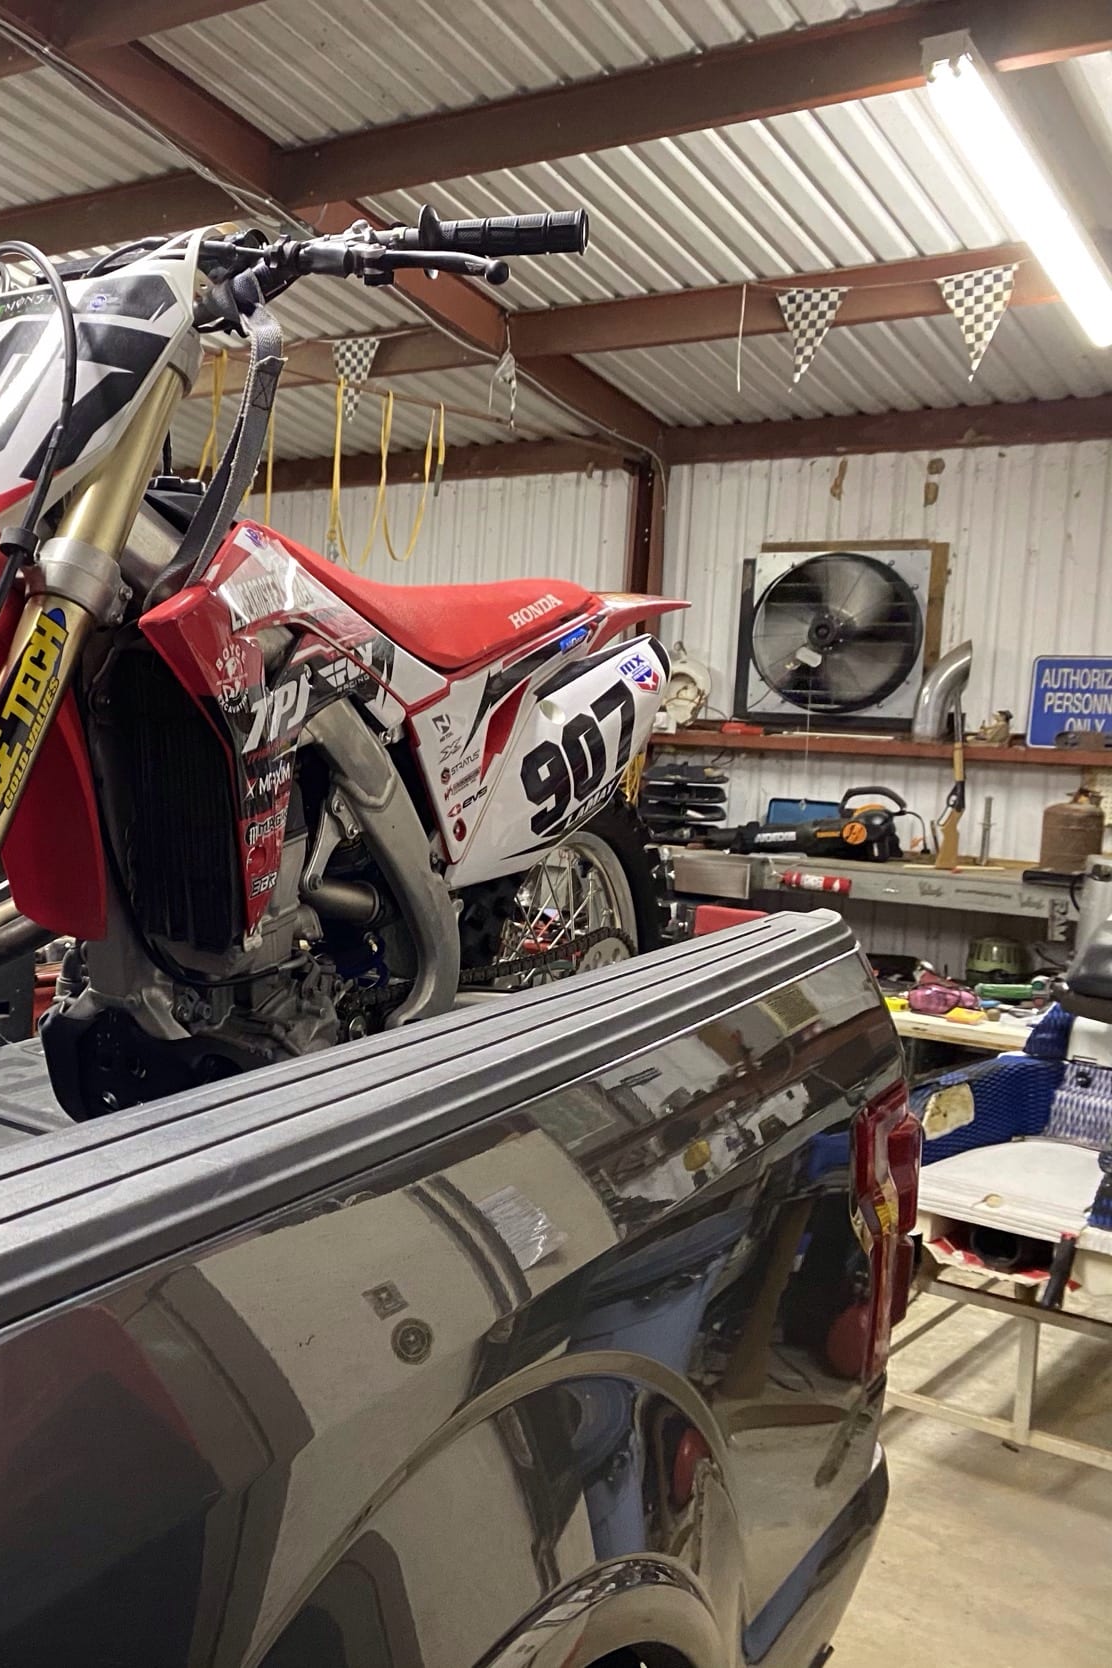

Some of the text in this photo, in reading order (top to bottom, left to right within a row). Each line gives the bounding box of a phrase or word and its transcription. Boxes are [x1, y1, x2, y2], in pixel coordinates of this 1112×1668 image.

[4, 294, 54, 312] MONST
[508, 594, 563, 630] HONDA
[1, 611, 69, 728] TECH
[216, 643, 246, 672] BOYCE
[242, 673, 310, 753] TPJ
[4, 675, 59, 810] GOLD VALVES
[520, 679, 635, 837] 907
[451, 750, 480, 776] STRATUS
[463, 786, 488, 809] EVS
